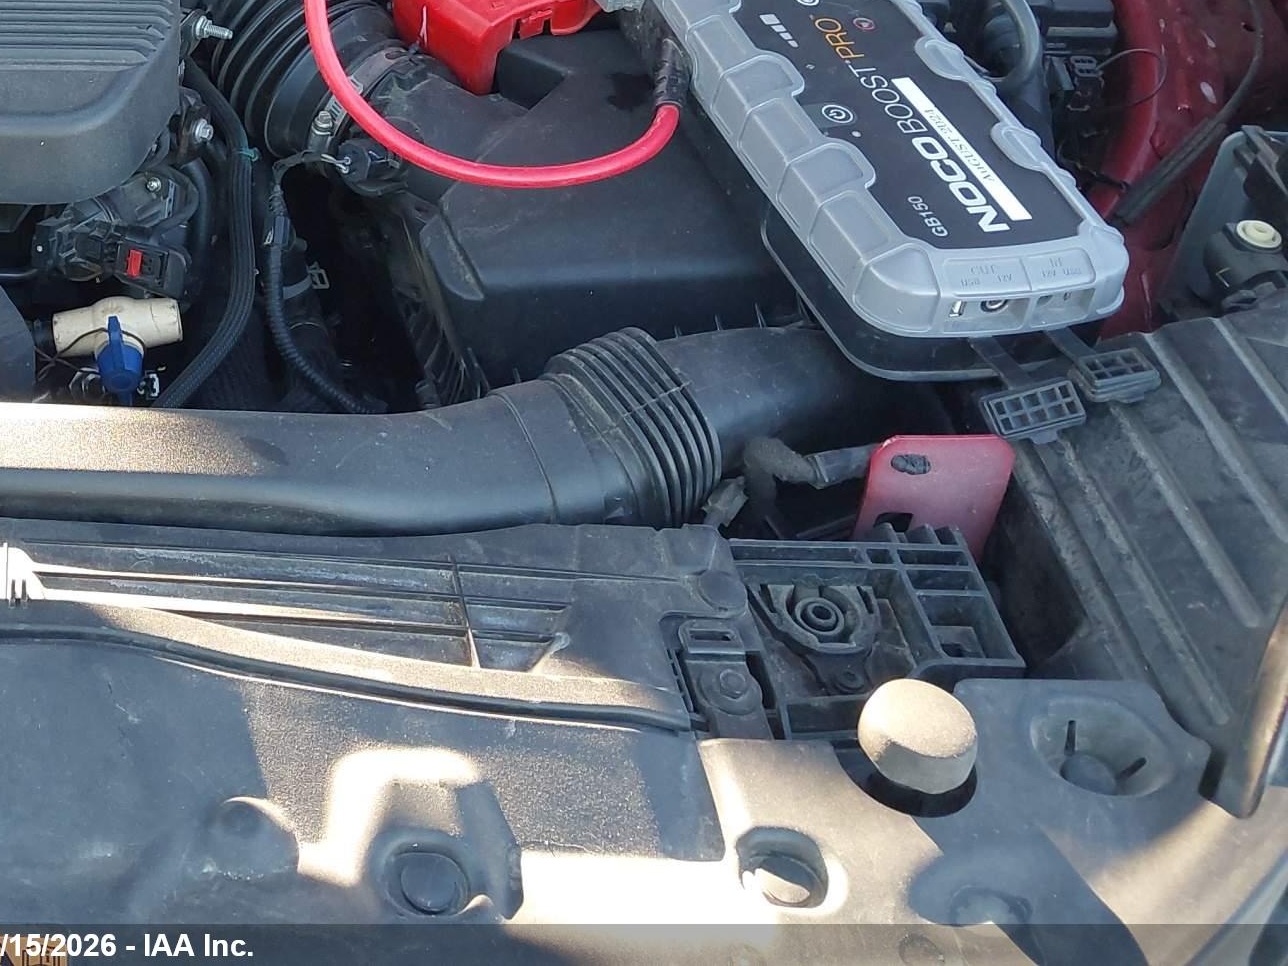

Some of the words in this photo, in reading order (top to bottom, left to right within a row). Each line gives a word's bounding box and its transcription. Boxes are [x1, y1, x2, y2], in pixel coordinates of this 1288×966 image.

[814, 18, 865, 59] PRO
[848, 63, 929, 134] BOOST
[912, 136, 1011, 233] NOCO
[907, 196, 949, 237] GB150
